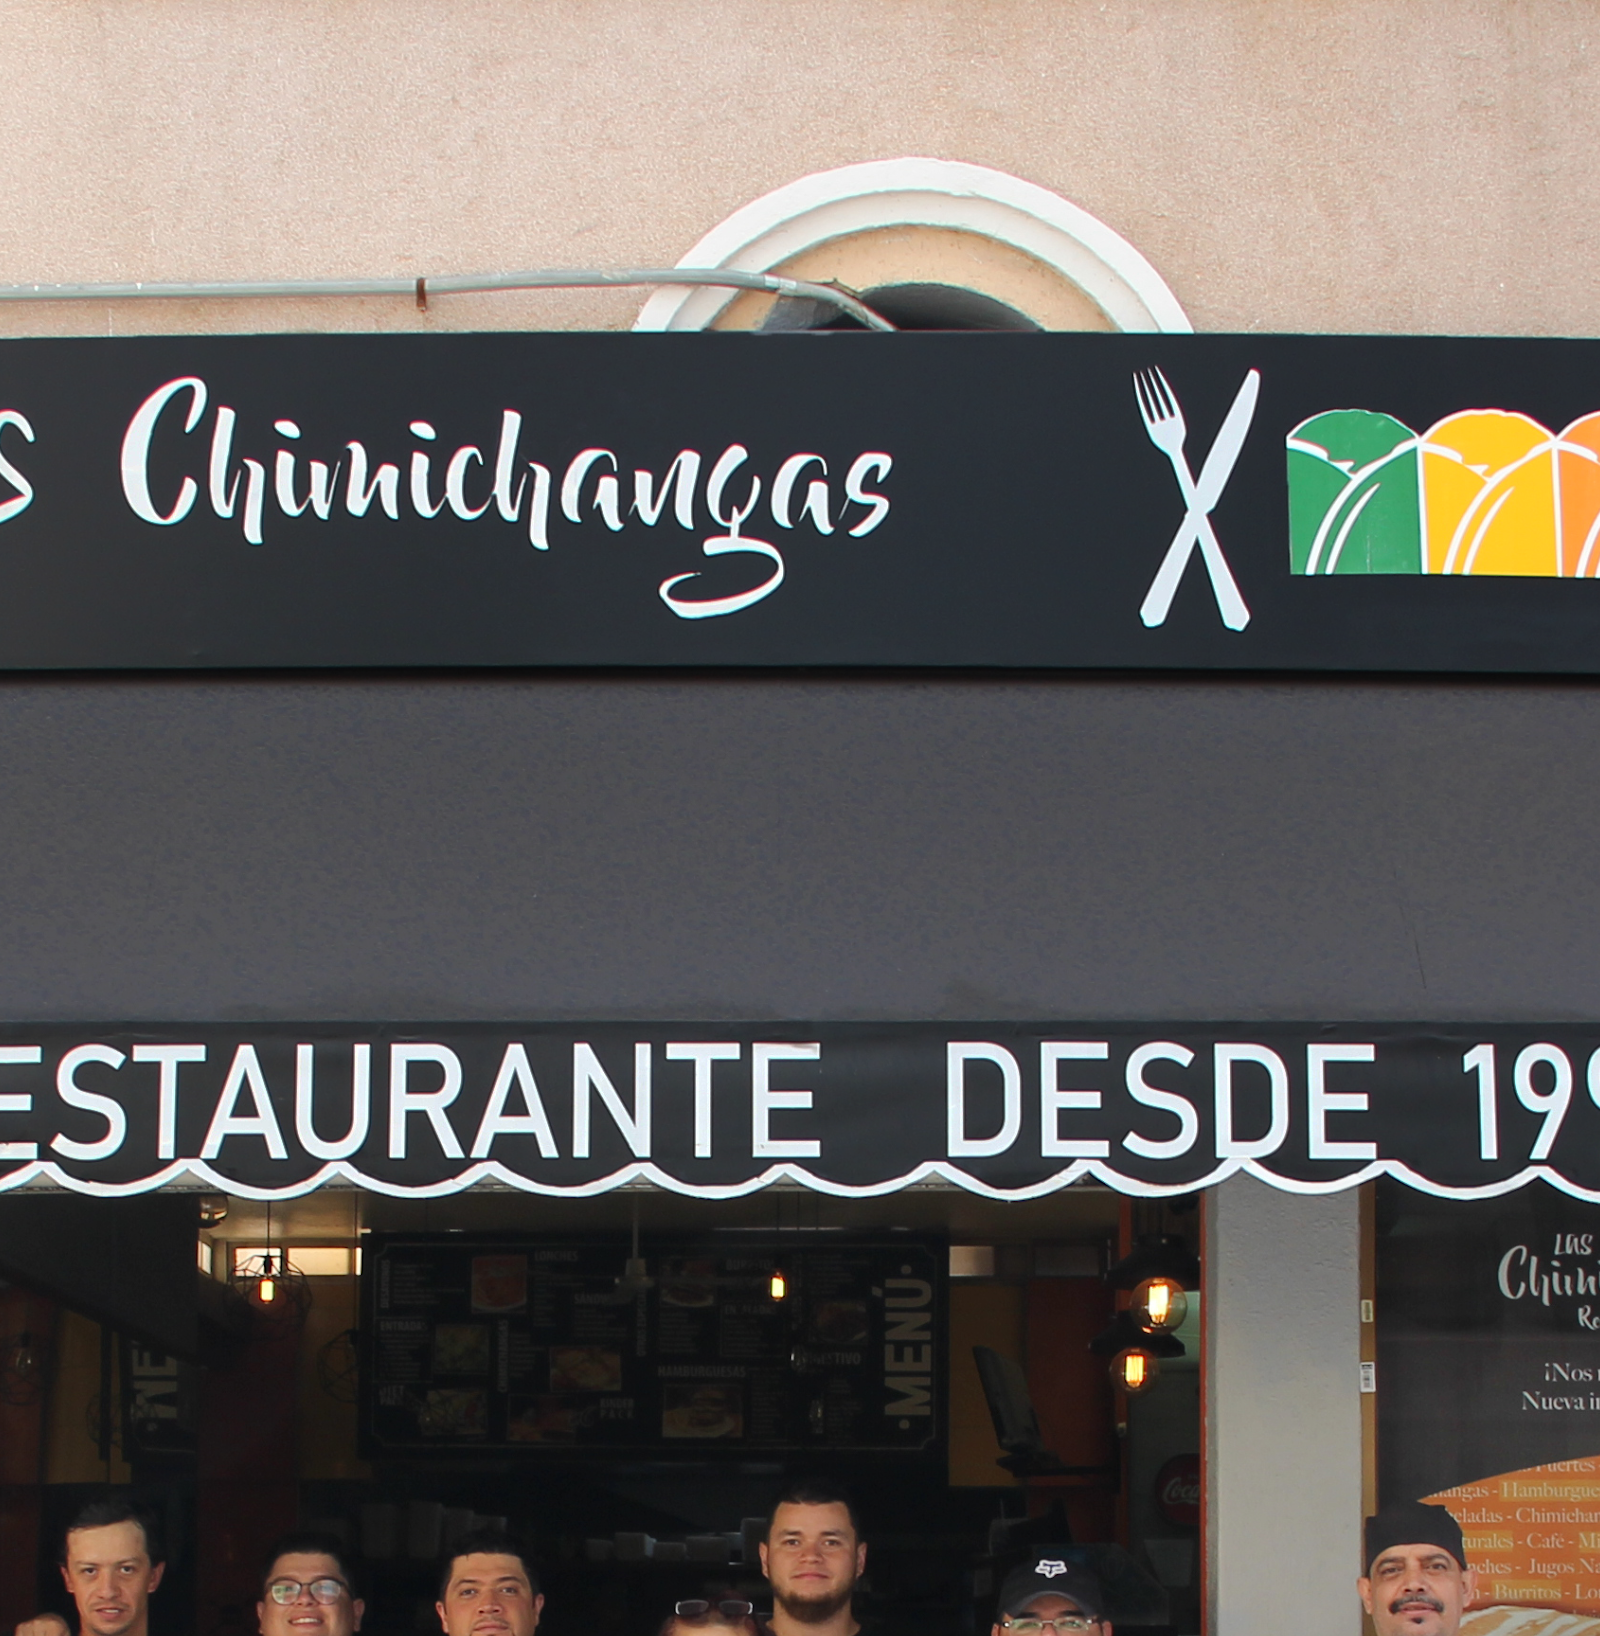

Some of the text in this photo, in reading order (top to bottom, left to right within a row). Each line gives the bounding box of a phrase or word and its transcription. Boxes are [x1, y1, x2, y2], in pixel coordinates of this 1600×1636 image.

[120, 375, 894, 620] Chimichangas
[946, 1041, 1377, 1160] DESDE
[872, 1278, 932, 1416] MENÚ
[658, 1365, 746, 1378] HAMBURGUESAS
[1544, 1363, 1593, 1382] ¡Nos
[1522, 1391, 1585, 1411] Nueva
[1526, 1532, 1564, 1549] Café
[1528, 1558, 1575, 1578] Jugos
[1495, 1583, 1562, 1600] Burritos
